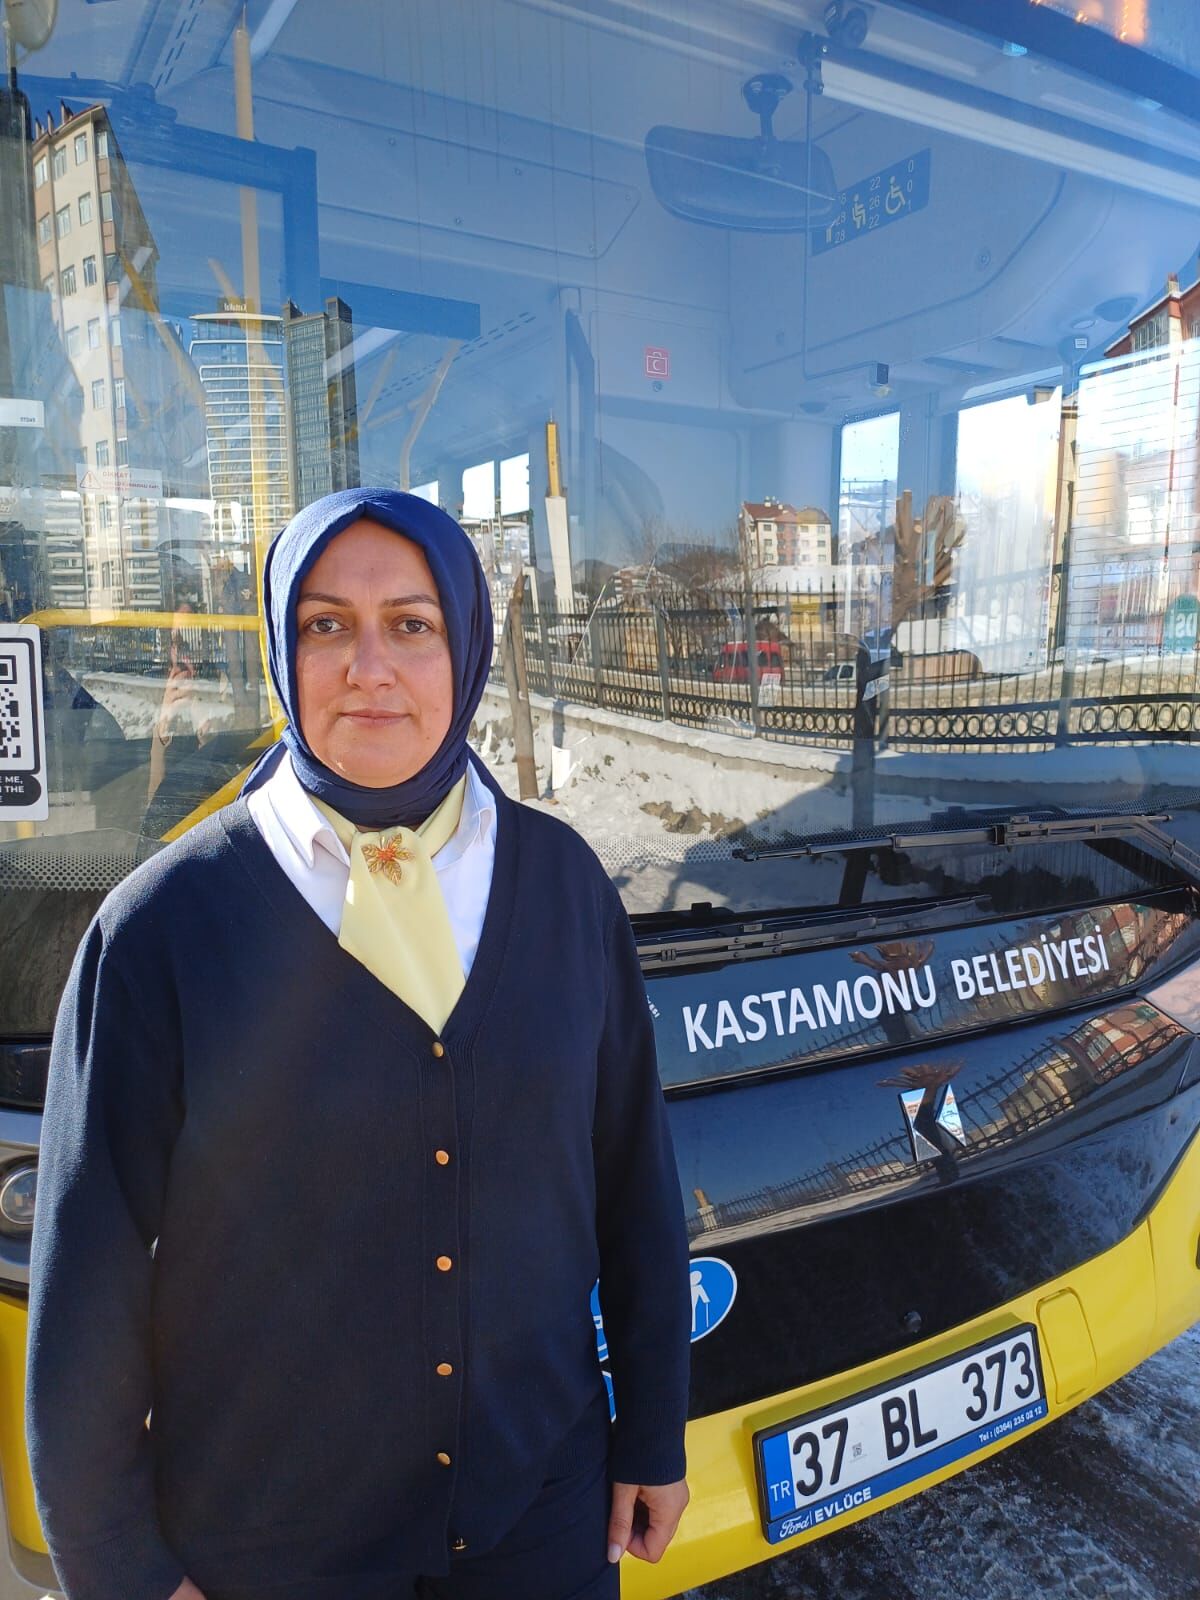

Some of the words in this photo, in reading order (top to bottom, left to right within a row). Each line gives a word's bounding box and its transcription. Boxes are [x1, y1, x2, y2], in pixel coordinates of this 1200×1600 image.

[5, 776, 23, 784] ME,
[682, 964, 937, 1054] KASTAMONU
[950, 925, 1110, 1001] BELEDİYESİ
[792, 1417, 849, 1497] 37
[881, 1388, 938, 1461] BL
[962, 1341, 1035, 1422] 373
[979, 1431, 989, 1443] Tel
[770, 1480, 792, 1502] TR
[779, 1515, 810, 1538] Ford
[814, 1487, 872, 1523] EVLÜCE
